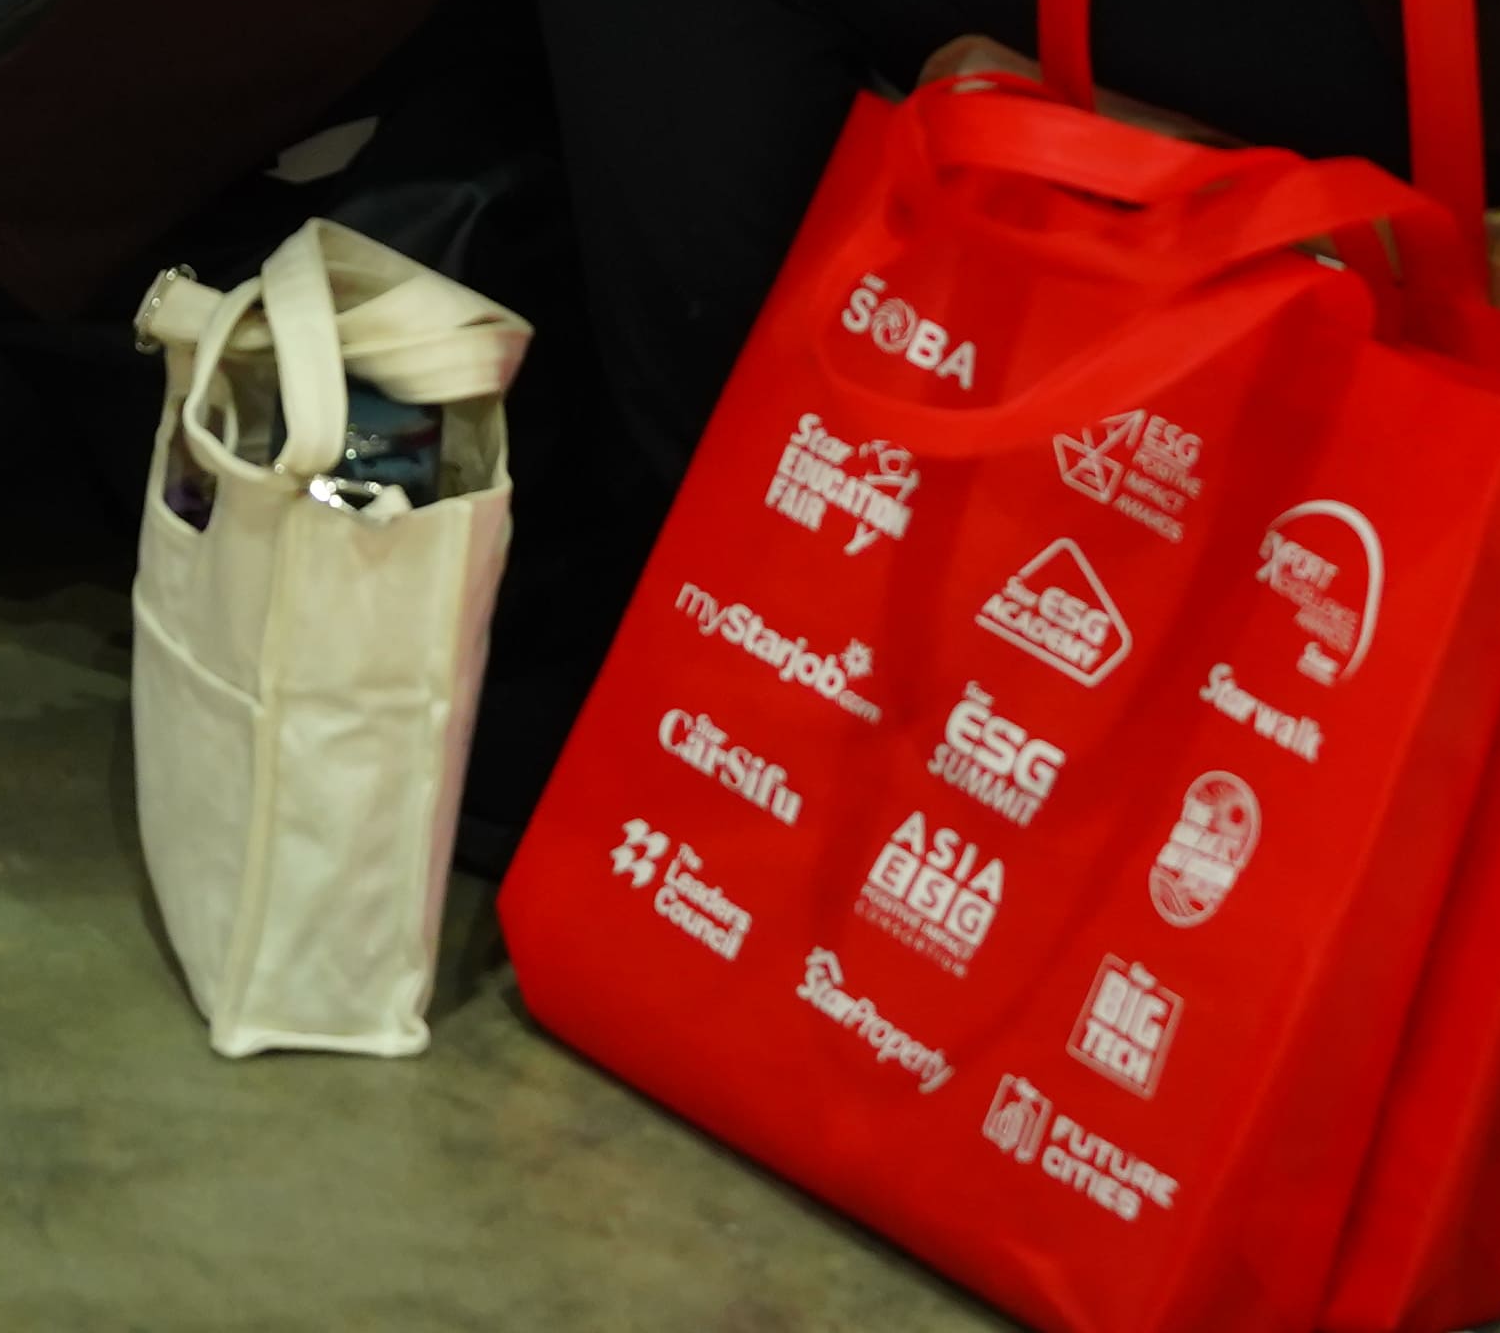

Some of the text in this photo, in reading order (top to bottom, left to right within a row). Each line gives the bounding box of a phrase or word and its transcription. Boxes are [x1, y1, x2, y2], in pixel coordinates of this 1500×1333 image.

[841, 287, 976, 390] SOBA
[790, 412, 855, 465] Star
[1143, 414, 1203, 468] ESG
[764, 474, 827, 532] FAIR
[778, 443, 914, 541] EDUCATION
[981, 593, 1102, 671] ACADEMY
[1038, 586, 1112, 647] ESG
[926, 742, 1042, 828] SUMMIT
[944, 699, 1067, 799] ESG
[873, 847, 991, 941] ESG
[890, 809, 1004, 904] ASIA
[1081, 1017, 1152, 1085] TECH
[1092, 969, 1168, 1053] BIG
[1040, 1143, 1142, 1222] CITIES
[1050, 1114, 1180, 1211] FUTURE
